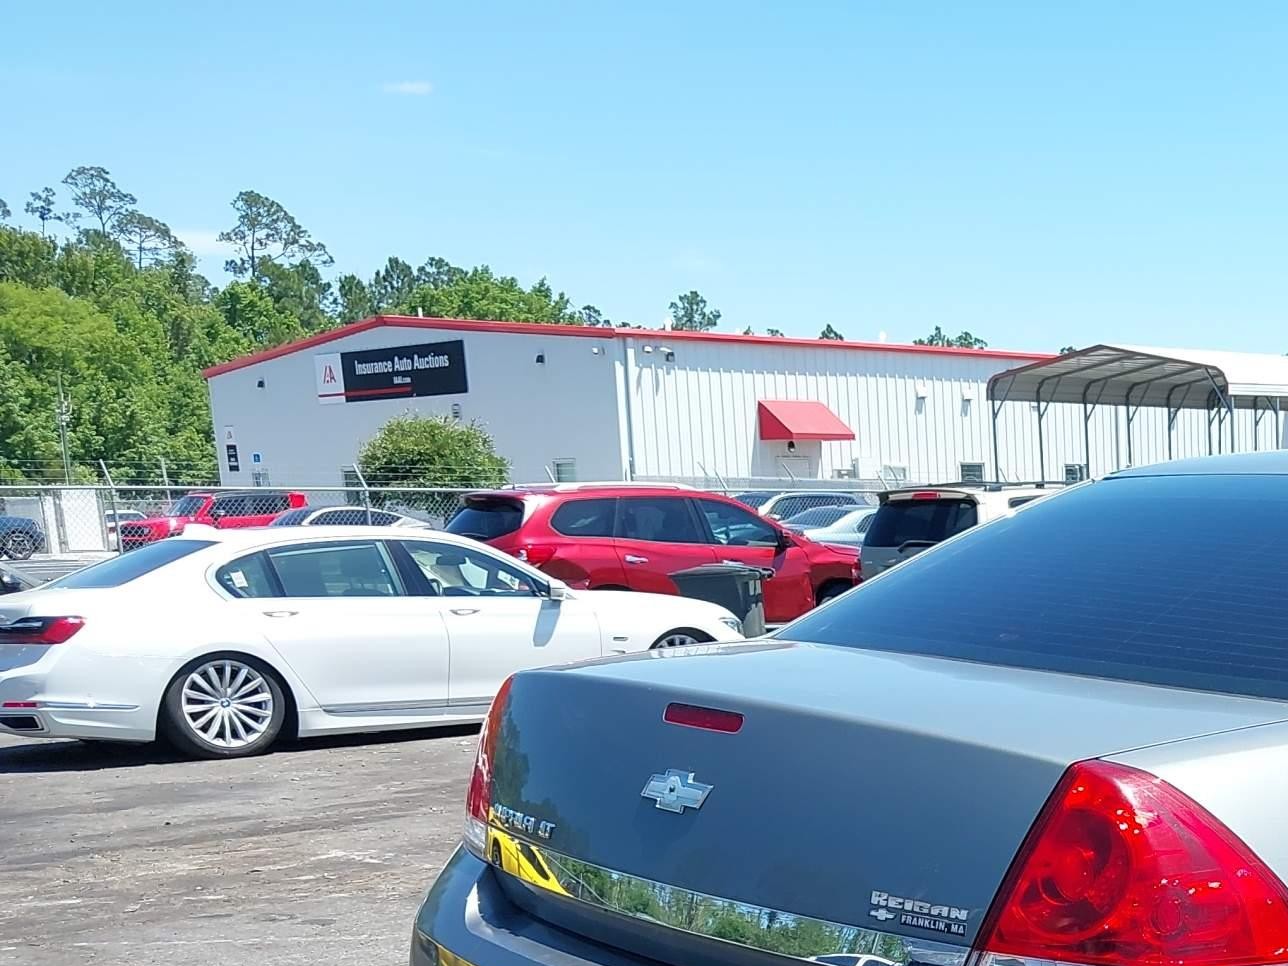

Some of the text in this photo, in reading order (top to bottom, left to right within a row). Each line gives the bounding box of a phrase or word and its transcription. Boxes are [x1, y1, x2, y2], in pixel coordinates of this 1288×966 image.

[354, 352, 450, 376] Insurance Auto Auctions
[900, 913, 965, 935] FRANKLIN, MA
